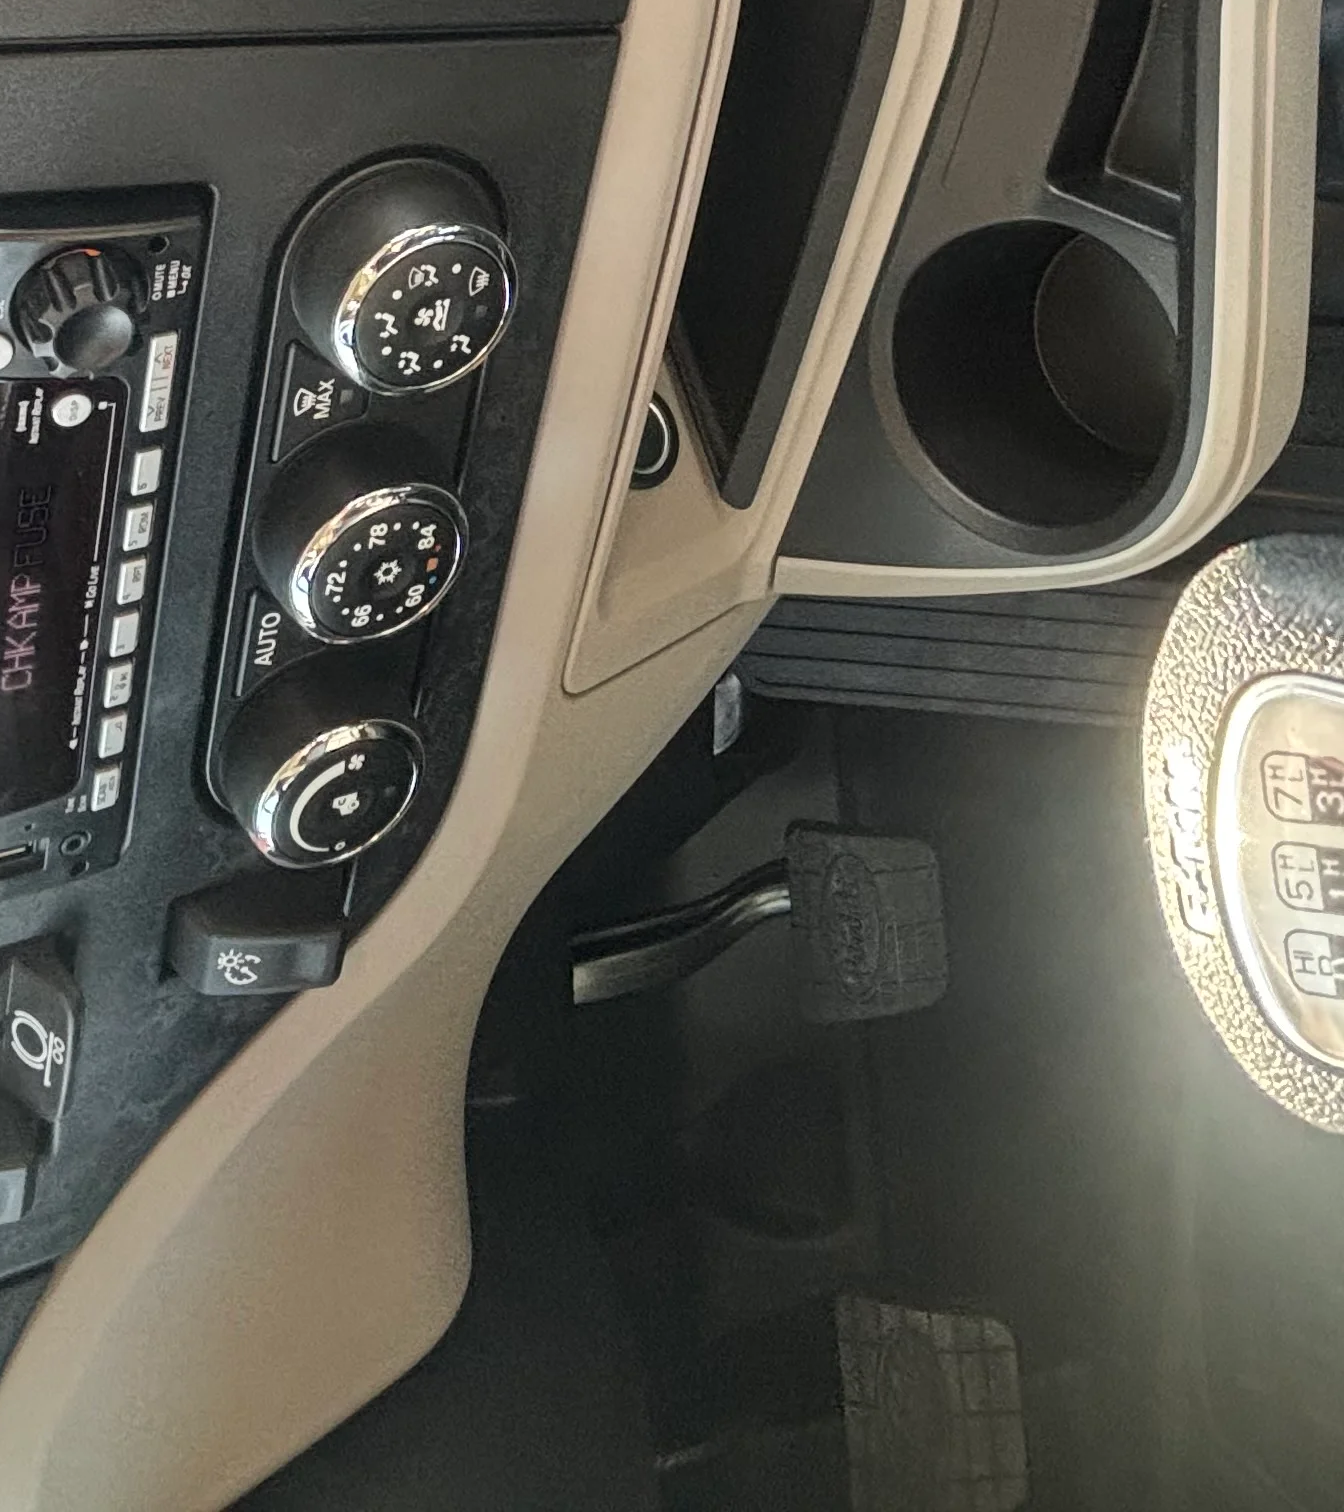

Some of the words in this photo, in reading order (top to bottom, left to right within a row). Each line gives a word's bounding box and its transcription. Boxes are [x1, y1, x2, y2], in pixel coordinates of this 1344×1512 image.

[153, 263, 167, 291] MUTE
[167, 260, 181, 288] MENU
[182, 264, 193, 279] OK
[155, 396, 167, 422] PREV
[162, 345, 174, 369] NEXT
[313, 379, 335, 420] MAX
[13, 485, 52, 567] FUSE
[368, 523, 388, 550] 78
[417, 523, 437, 550] 84
[325, 571, 347, 596] 72
[405, 584, 425, 607] 60
[6, 573, 41, 629] AMP
[351, 604, 373, 627] 66
[254, 612, 281, 666] AUTO
[0, 631, 37, 692] CHK
[1273, 786, 1303, 810] 7
[1285, 878, 1314, 900] 5
[1293, 951, 1316, 975] HI
